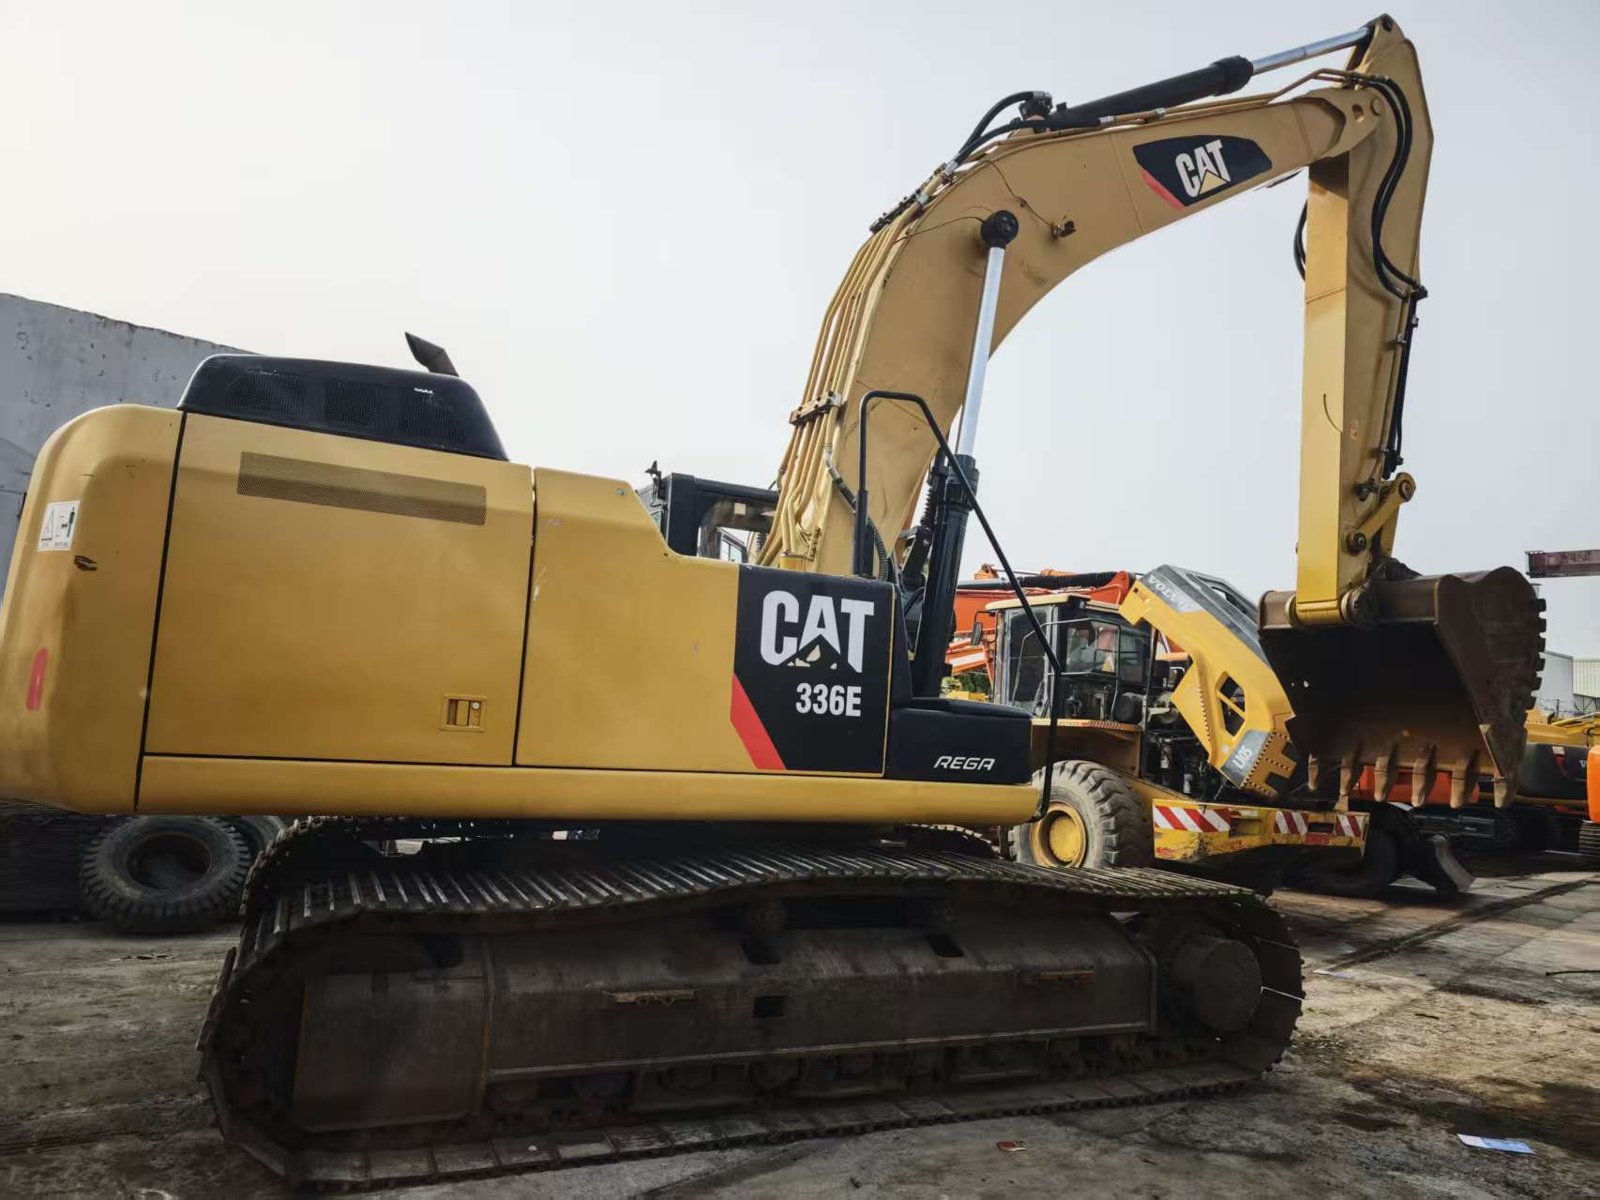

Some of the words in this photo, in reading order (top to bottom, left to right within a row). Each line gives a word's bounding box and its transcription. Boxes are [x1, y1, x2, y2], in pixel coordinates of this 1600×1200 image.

[1175, 139, 1231, 197] CAT
[760, 590, 875, 673] CAT
[796, 683, 862, 717] 336E
[933, 755, 996, 771] REGA
